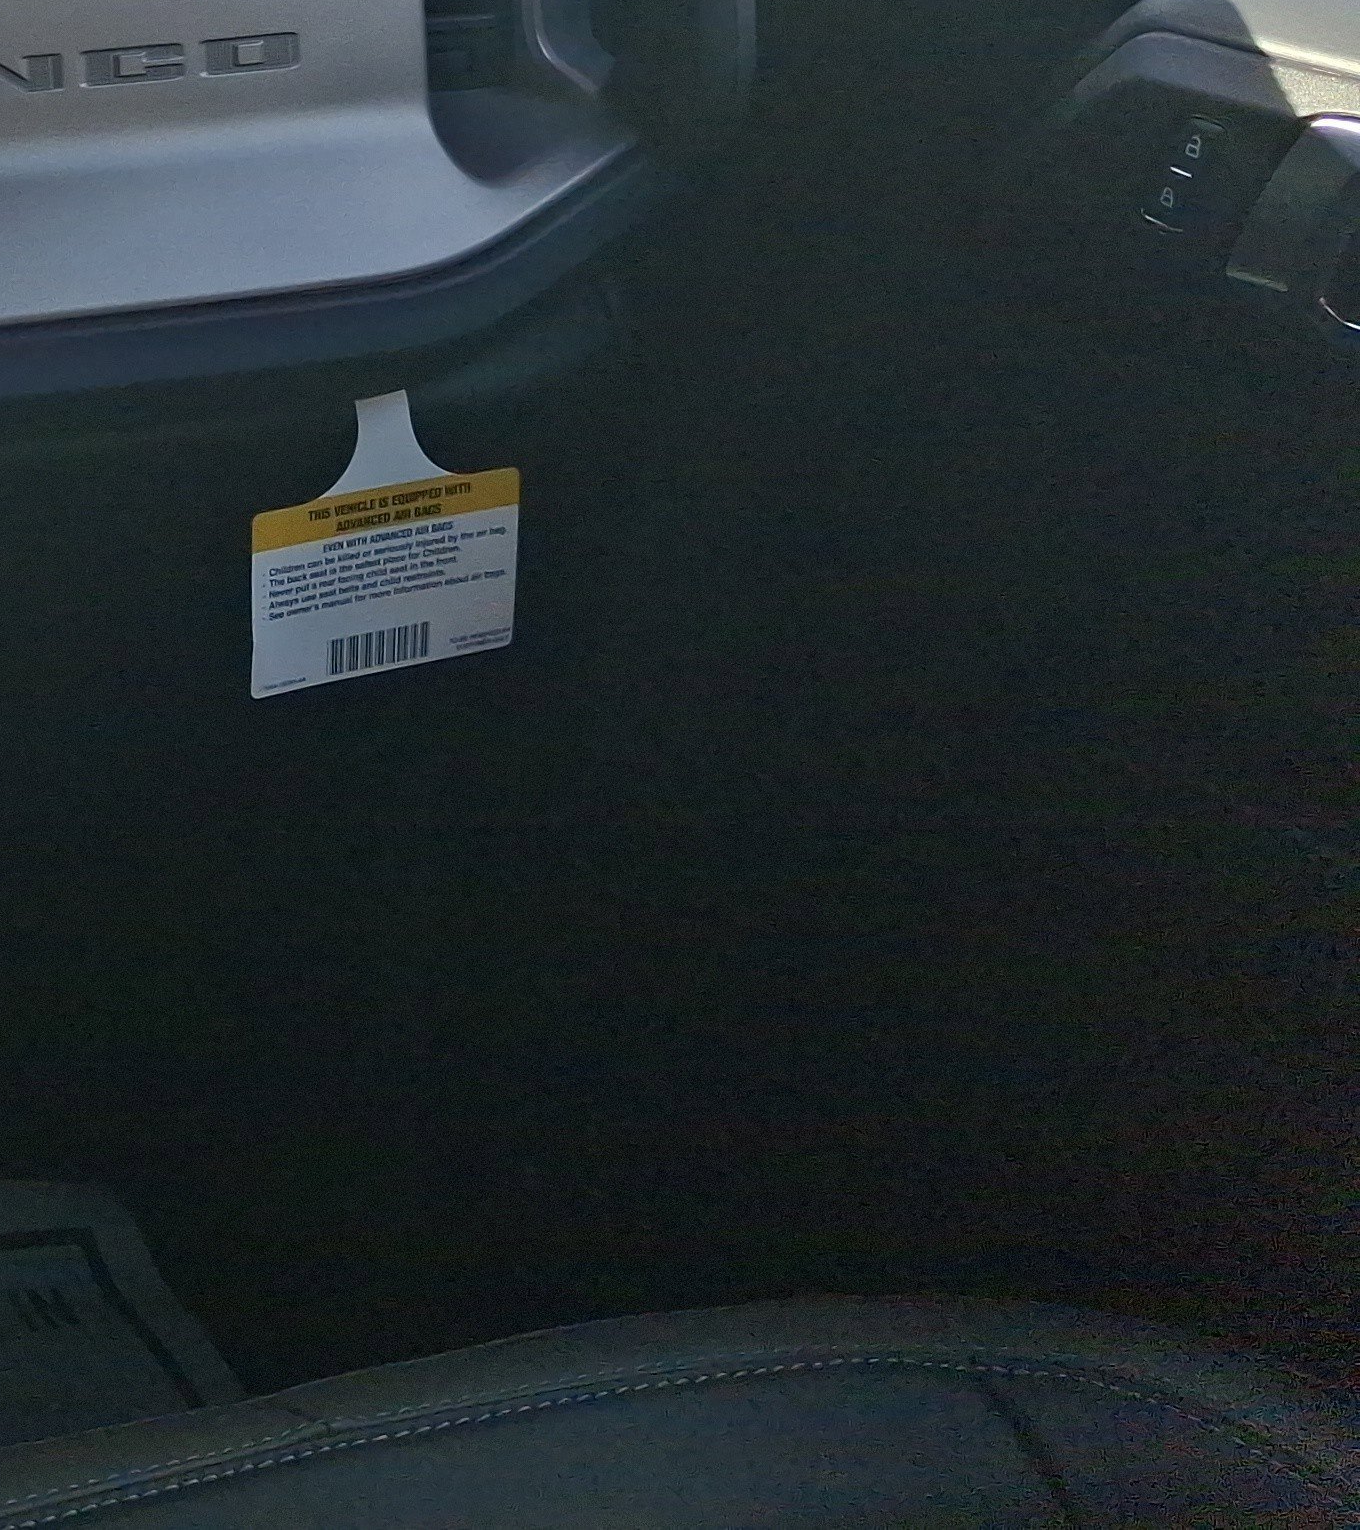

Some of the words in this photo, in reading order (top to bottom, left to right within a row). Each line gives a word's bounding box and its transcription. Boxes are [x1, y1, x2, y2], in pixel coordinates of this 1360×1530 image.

[308, 509, 330, 521] THIS
[334, 498, 376, 516] VEHICLE
[379, 498, 388, 508] IS
[392, 488, 442, 506] EQUIPPED
[444, 482, 470, 494] WITH
[336, 512, 390, 532] ADVANCED
[393, 508, 412, 521] AIR
[414, 504, 442, 516] BAGS
[269, 563, 305, 576] Children
[307, 560, 323, 570] can
[325, 556, 335, 565] be
[338, 550, 360, 562] killed
[374, 542, 414, 556] seriously
[416, 536, 446, 550] injured
[448, 534, 458, 545] by
[323, 541, 344, 553] EVEN
[346, 538, 368, 550] WITH
[370, 529, 412, 544] ADVANCED
[415, 526, 429, 536] AIR
[432, 522, 454, 533] BAGS
[269, 578, 284, 588] The
[287, 574, 306, 584] back
[309, 570, 328, 580] seat
[330, 568, 337, 576] is
[339, 564, 352, 574] the
[355, 558, 380, 570] safest
[382, 554, 406, 566] place
[408, 550, 420, 560] for
[269, 588, 293, 600] Never
[295, 585, 310, 596] put
[319, 578, 336, 588] rear
[338, 572, 364, 585] facing
[366, 567, 388, 578] child
[390, 564, 408, 574] seat
[410, 562, 418, 570] in
[420, 559, 434, 568] the
[269, 597, 300, 610] Always
[302, 594, 316, 604] use
[318, 590, 336, 600] seat
[338, 584, 360, 596] belts
[362, 581, 378, 591] and
[380, 576, 401, 586] child
[269, 610, 284, 620] See
[322, 596, 352, 610] manual
[354, 592, 366, 602] for
[368, 588, 392, 601] more
[17, 1285, 83, 1331] IN
